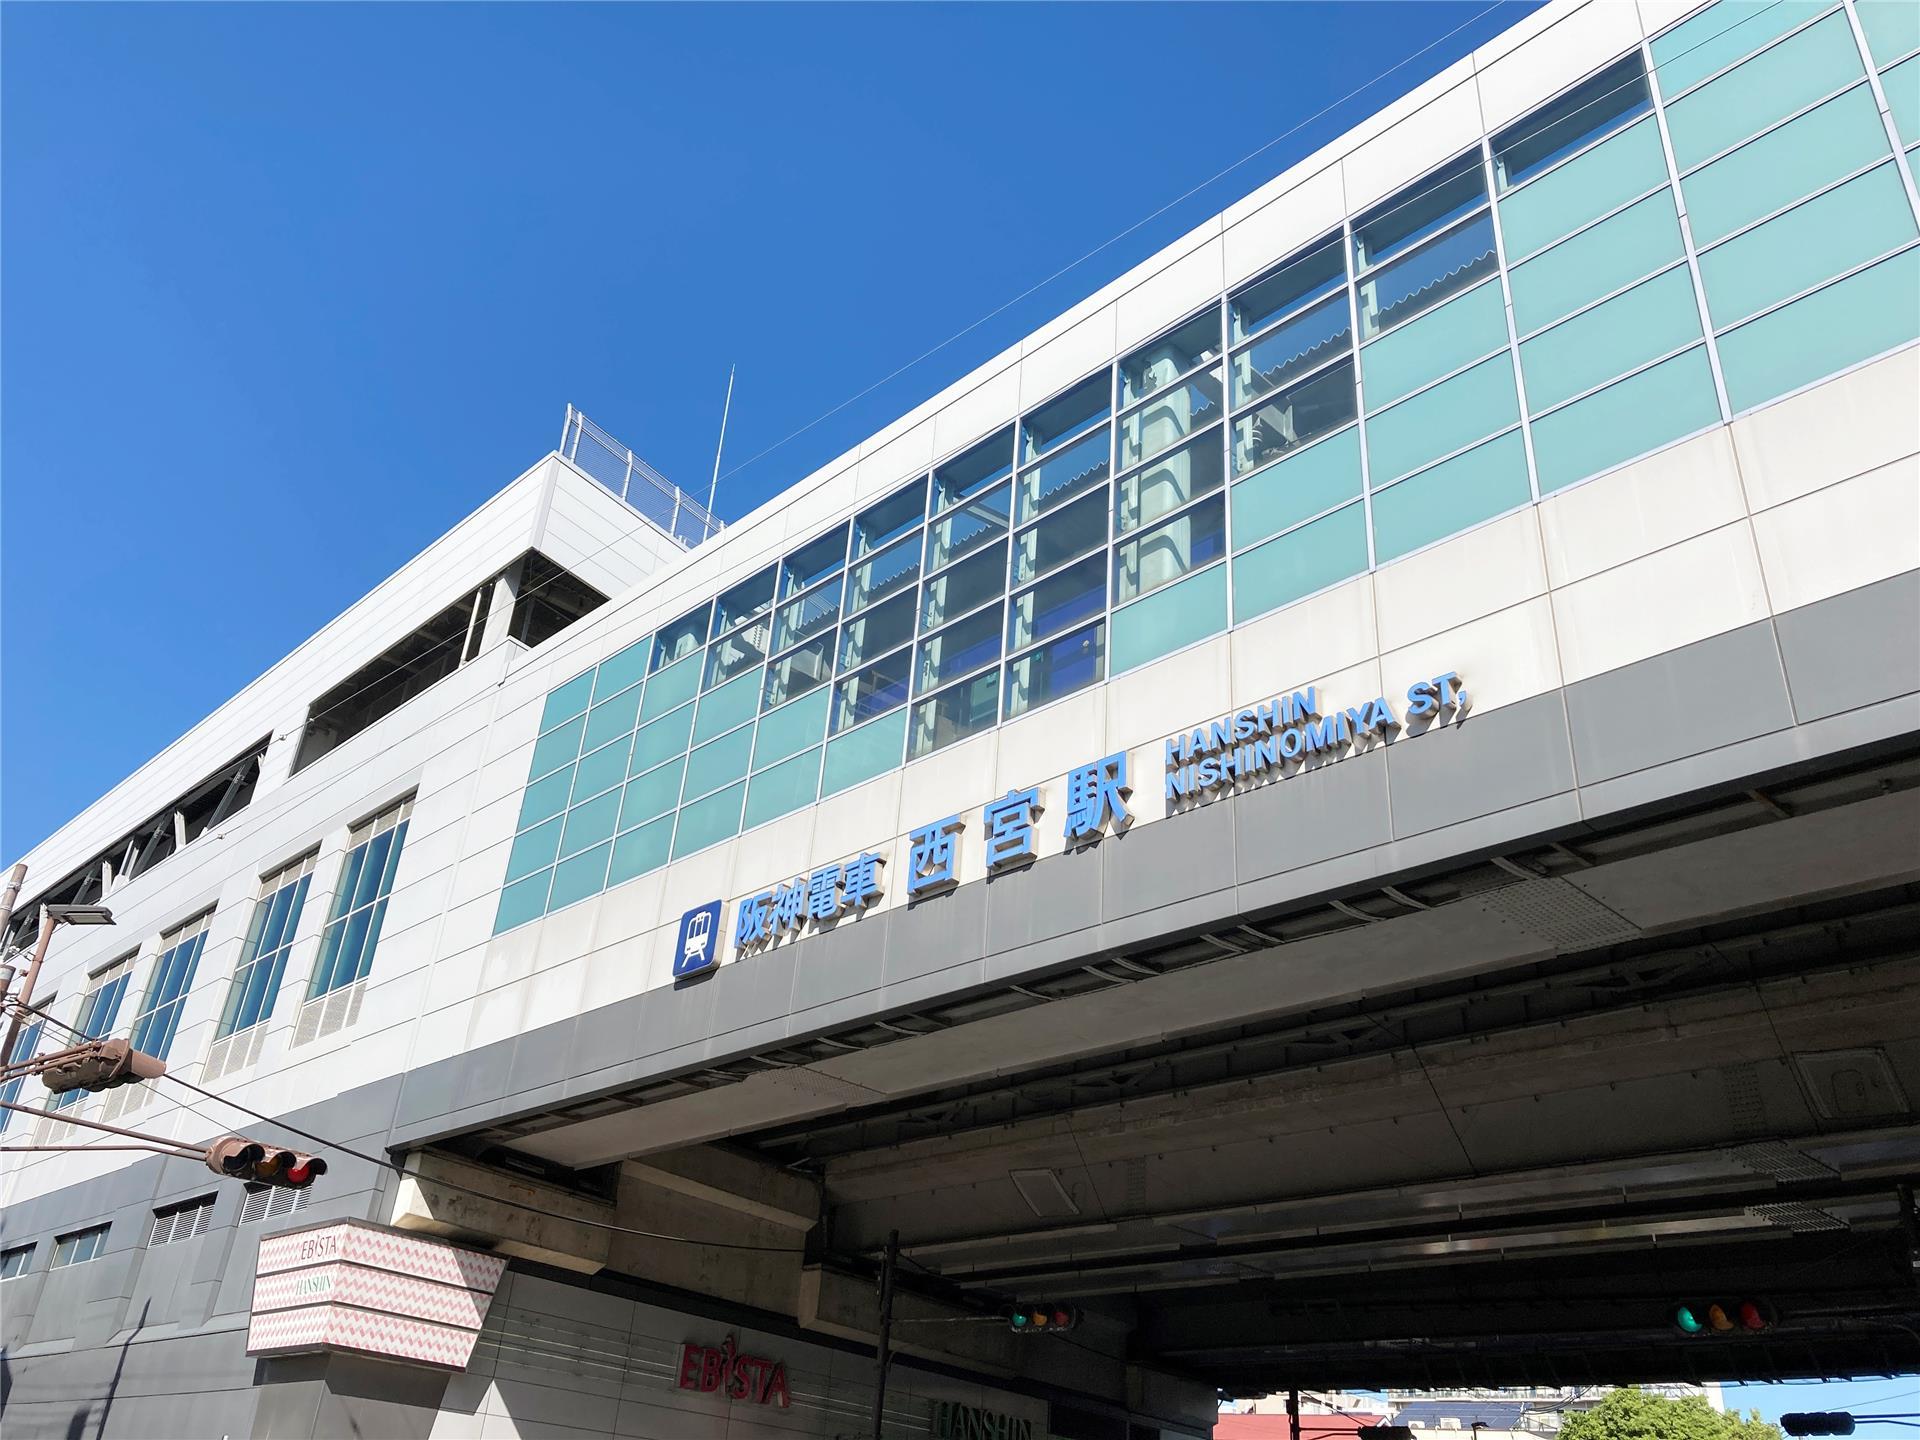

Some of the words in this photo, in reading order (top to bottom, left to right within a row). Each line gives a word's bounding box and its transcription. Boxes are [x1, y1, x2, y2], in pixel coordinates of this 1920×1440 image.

[1165, 686, 1316, 767] HANSHIN
[1165, 697, 1394, 800] NISHINOMIYA
[734, 852, 886, 949] 阪神電車
[907, 751, 1134, 895] 西宮駅
